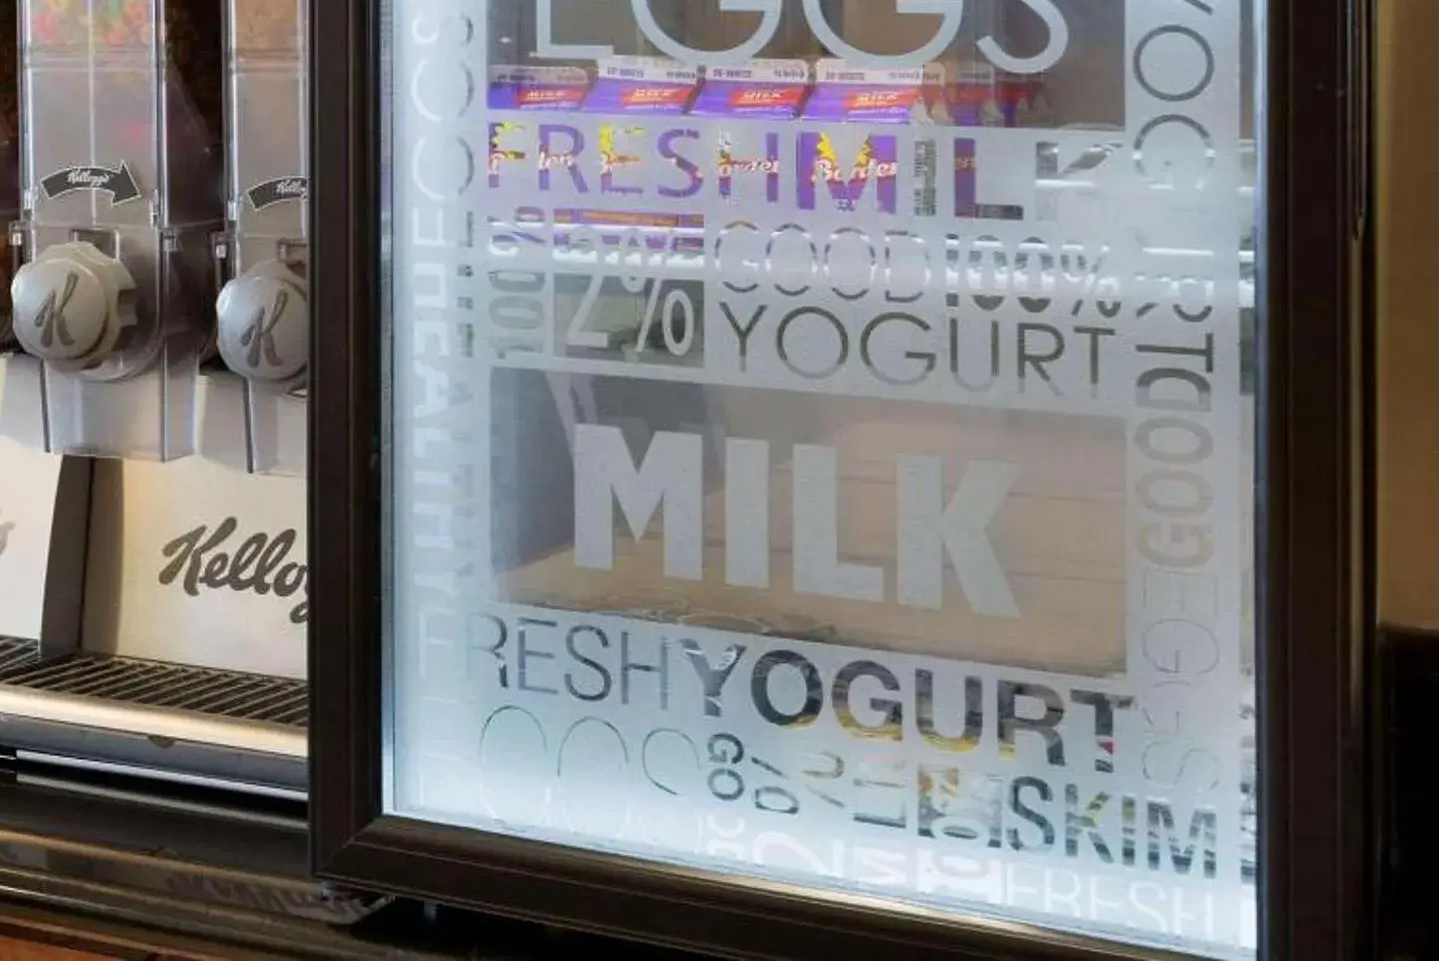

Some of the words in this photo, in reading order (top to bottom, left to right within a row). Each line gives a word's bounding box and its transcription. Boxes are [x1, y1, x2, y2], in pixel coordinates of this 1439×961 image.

[67, 170, 109, 187] Kellogg's
[487, 121, 780, 204] FRESH
[795, 131, 1127, 225] MILK
[719, 301, 1116, 399] YOGURT
[1136, 367, 1215, 570] GOOD
[573, 422, 1022, 619] MILK
[678, 638, 1135, 774] YOGURT
[1006, 774, 1218, 881] SKIM
